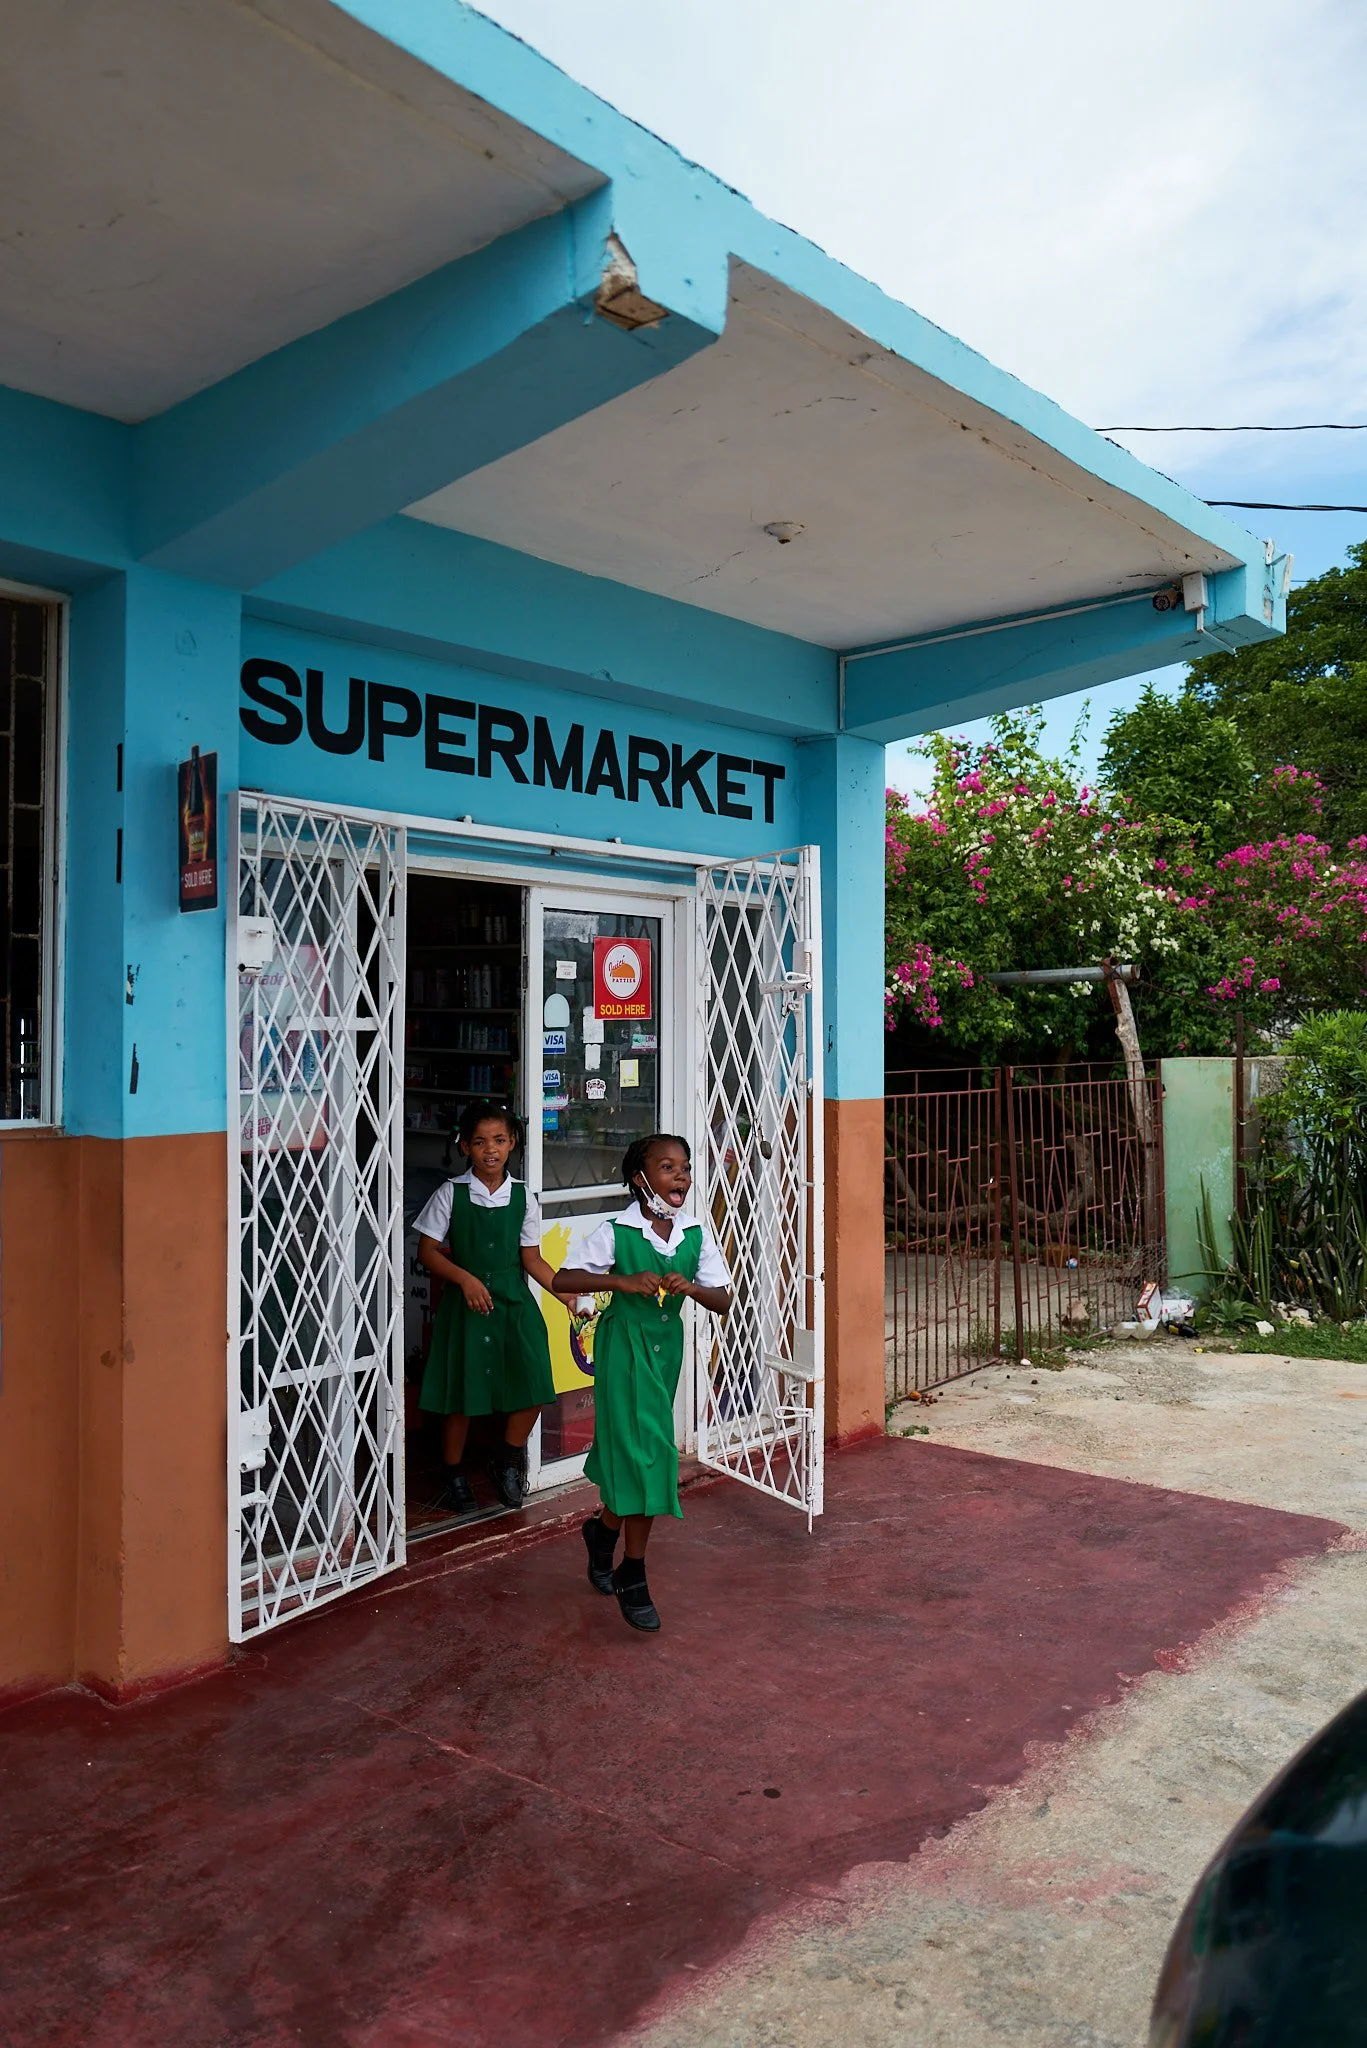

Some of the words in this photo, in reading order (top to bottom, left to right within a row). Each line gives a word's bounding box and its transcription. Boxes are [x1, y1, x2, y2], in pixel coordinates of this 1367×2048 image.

[240, 658, 785, 823] SUPERMARKET
[184, 871, 198, 888] SOLD
[199, 868, 212, 885] HERE
[600, 1004, 623, 1015] SOLD
[624, 1004, 646, 1015] HERE
[544, 1034, 564, 1044] VISA
[411, 1286, 428, 1299] AND
